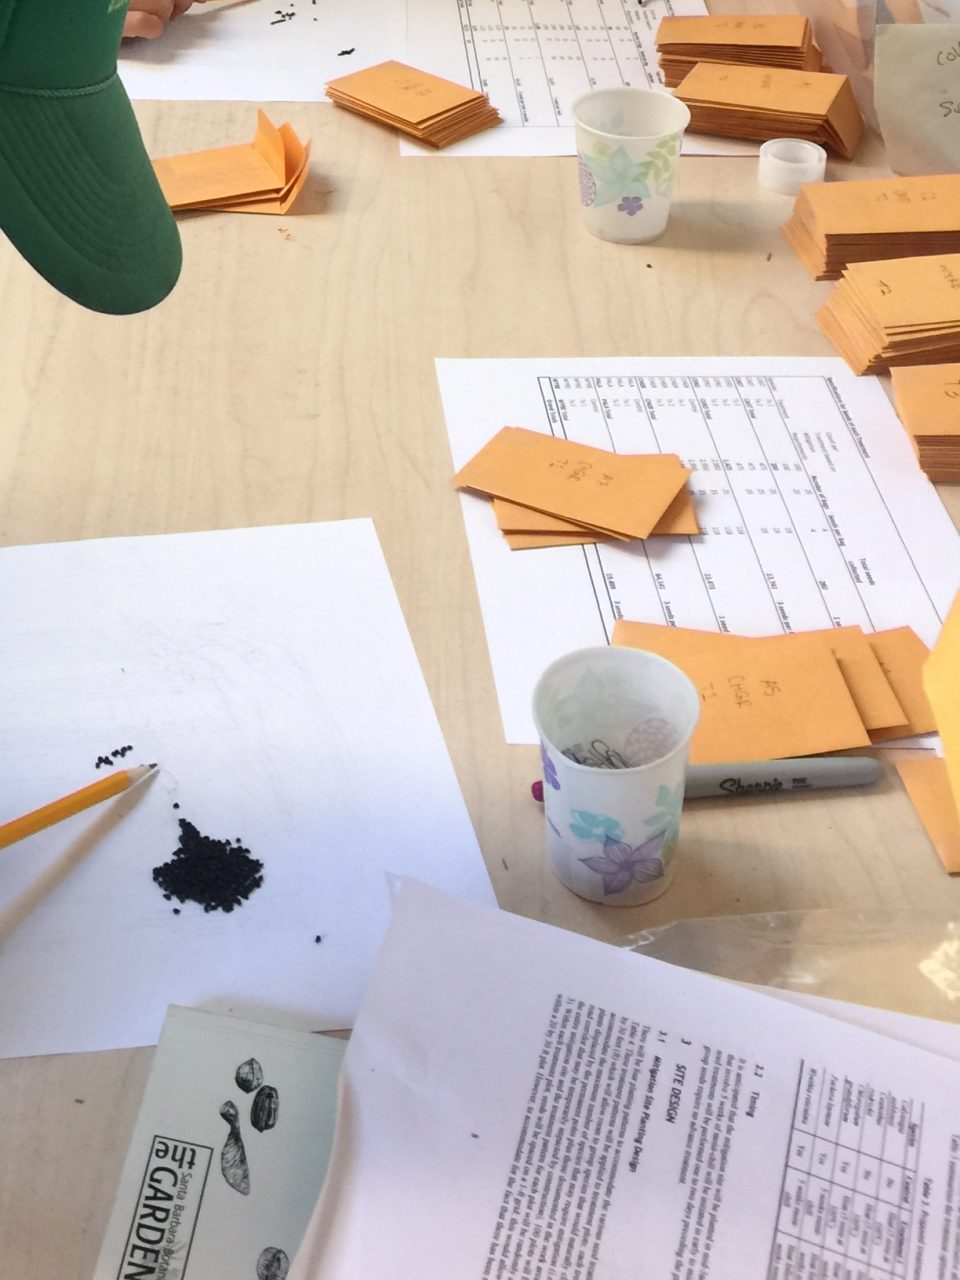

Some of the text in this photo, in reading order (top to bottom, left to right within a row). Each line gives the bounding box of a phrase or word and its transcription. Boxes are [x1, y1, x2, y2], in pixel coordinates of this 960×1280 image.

[855, 437, 870, 458] Treatment
[810, 476, 823, 492] Number
[827, 515, 839, 527] Seeds
[836, 537, 847, 546] bag
[847, 561, 863, 583] collected
[859, 558, 875, 584] Total seeds
[719, 777, 783, 794] Sharpie
[629, 1021, 640, 1039] Table
[639, 1024, 650, 1044] There
[622, 1048, 633, 1067] These
[636, 1044, 646, 1058] will
[699, 1044, 711, 1066] group
[615, 1067, 629, 1100] treatment
[630, 1067, 640, 1082] four
[664, 1037, 692, 1124] 3 SITE DESIGN
[707, 1065, 720, 1101] treatments
[623, 1081, 637, 1110] planting
[728, 1071, 743, 1109] anticipated
[745, 1063, 764, 1118] 2.2 Timing
[627, 1030, 667, 1173] 3.1 Mitigation Site Planting Design
[704, 1101, 713, 1116] will
[607, 1099, 621, 1128] patterns
[616, 1110, 631, 1139] patterns
[727, 1109, 737, 1124] that
[604, 1128, 614, 1143] will
[725, 1123, 734, 1136] the
[155, 1141, 196, 1169] the
[693, 1125, 709, 1163] performed
[717, 1135, 732, 1173] mitigation
[594, 1153, 608, 1181] applied
[604, 1148, 622, 1198] accommodate
[715, 1173, 725, 1186] site
[601, 1198, 611, 1211] the
[687, 1186, 697, 1202] two
[713, 1187, 722, 1202] will
[585, 1190, 600, 1226] treatment
[682, 1200, 694, 1219] days
[711, 1202, 720, 1212] be
[124, 1166, 178, 1280] GARDEN
[157, 1172, 193, 1280] Santa Barbara Botan
[594, 1212, 607, 1241] various
[704, 1212, 718, 1242] planted
[575, 1249, 586, 1269] each
[590, 1241, 601, 1260] seed
[673, 1258, 683, 1271] the
